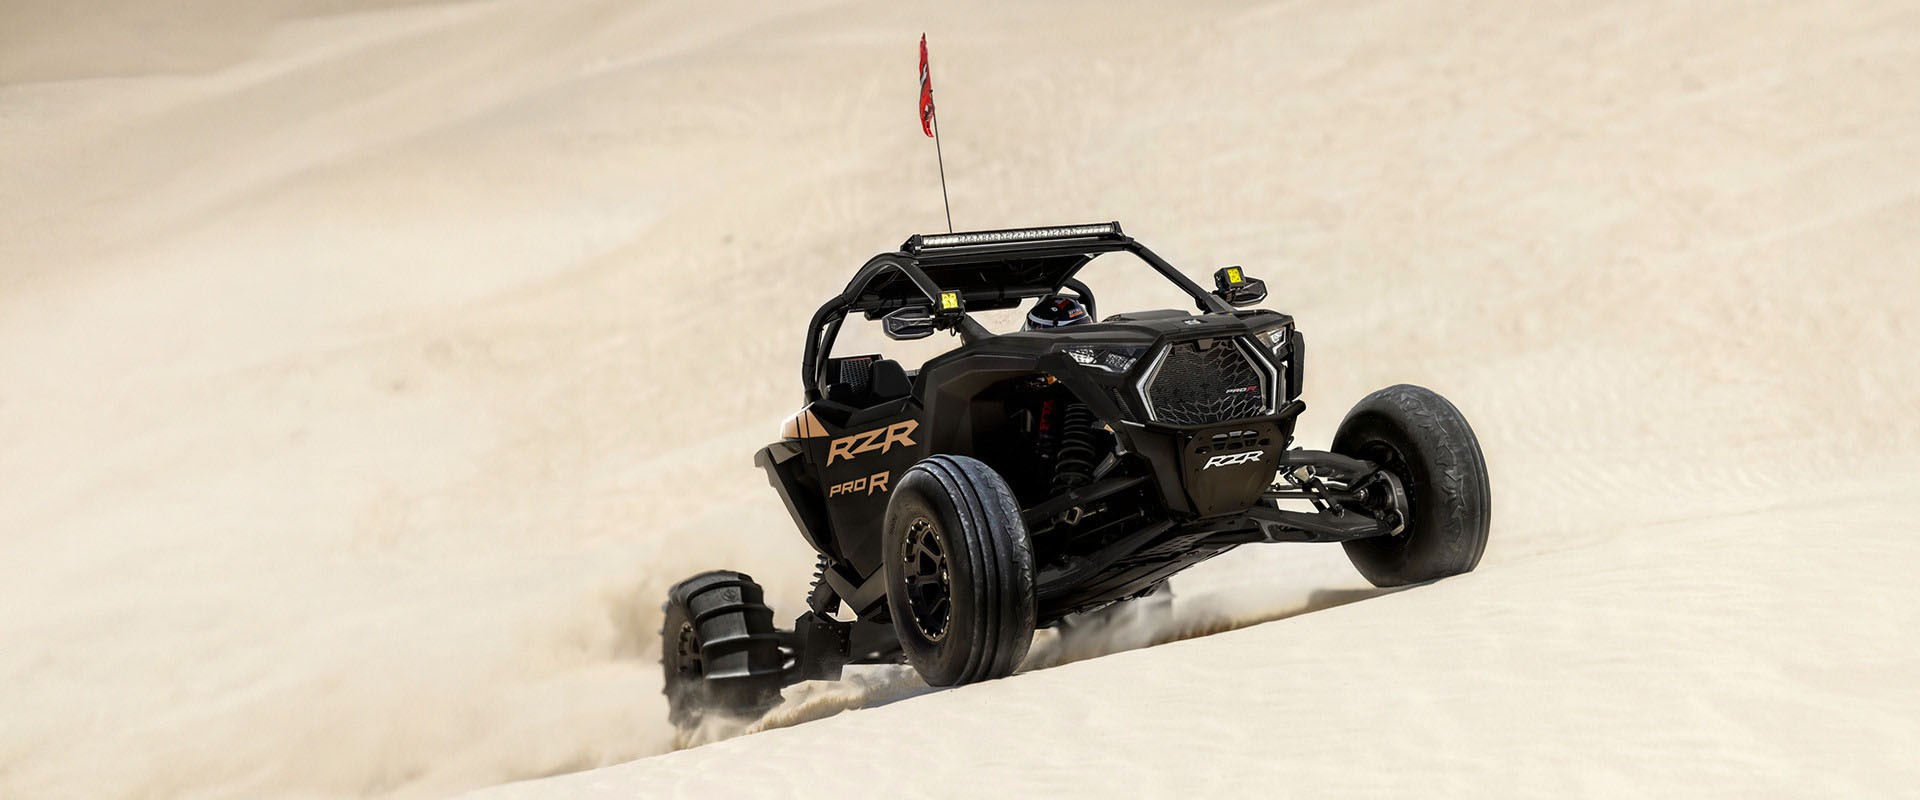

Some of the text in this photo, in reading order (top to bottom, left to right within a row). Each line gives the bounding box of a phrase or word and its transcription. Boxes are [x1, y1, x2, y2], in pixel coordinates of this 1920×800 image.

[827, 419, 919, 467] RZR
[1203, 451, 1264, 470] RZR
[829, 471, 890, 498] PRO R
